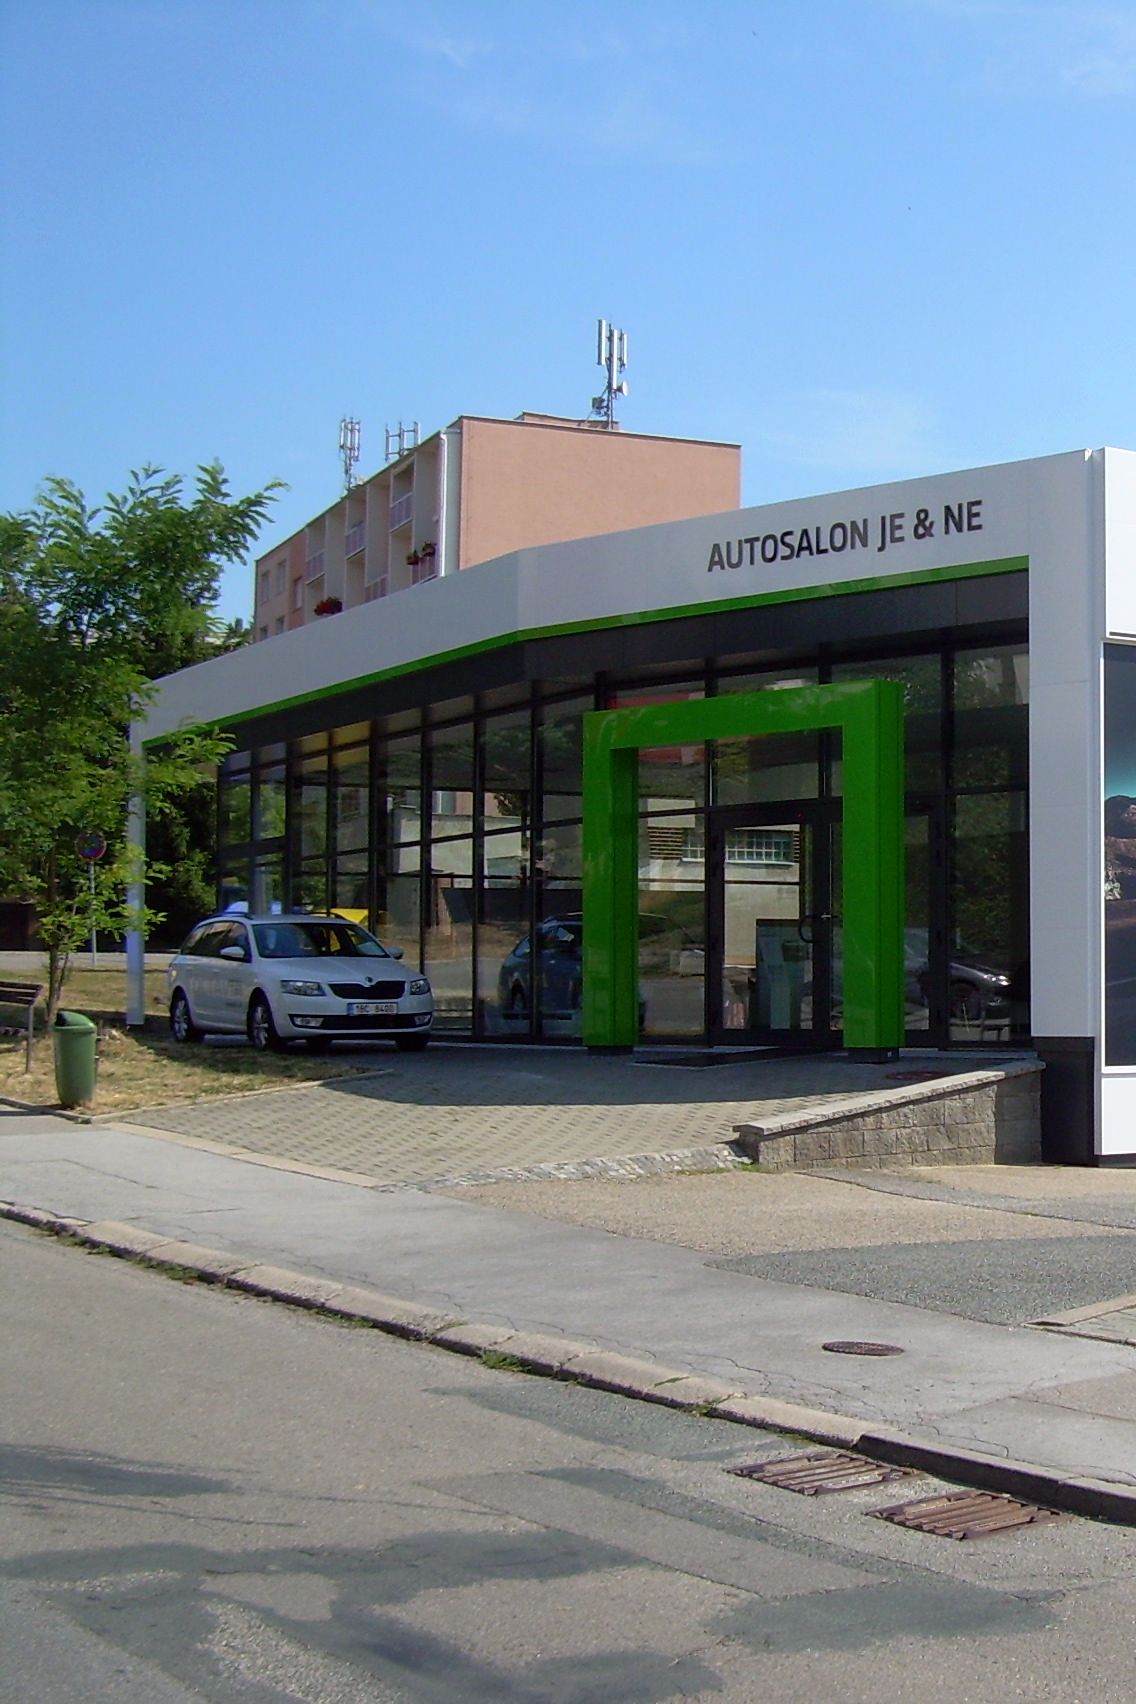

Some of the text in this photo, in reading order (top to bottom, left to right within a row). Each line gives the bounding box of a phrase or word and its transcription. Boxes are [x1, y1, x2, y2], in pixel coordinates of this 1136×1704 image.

[707, 499, 983, 573] AUTOSALON JE & NE
